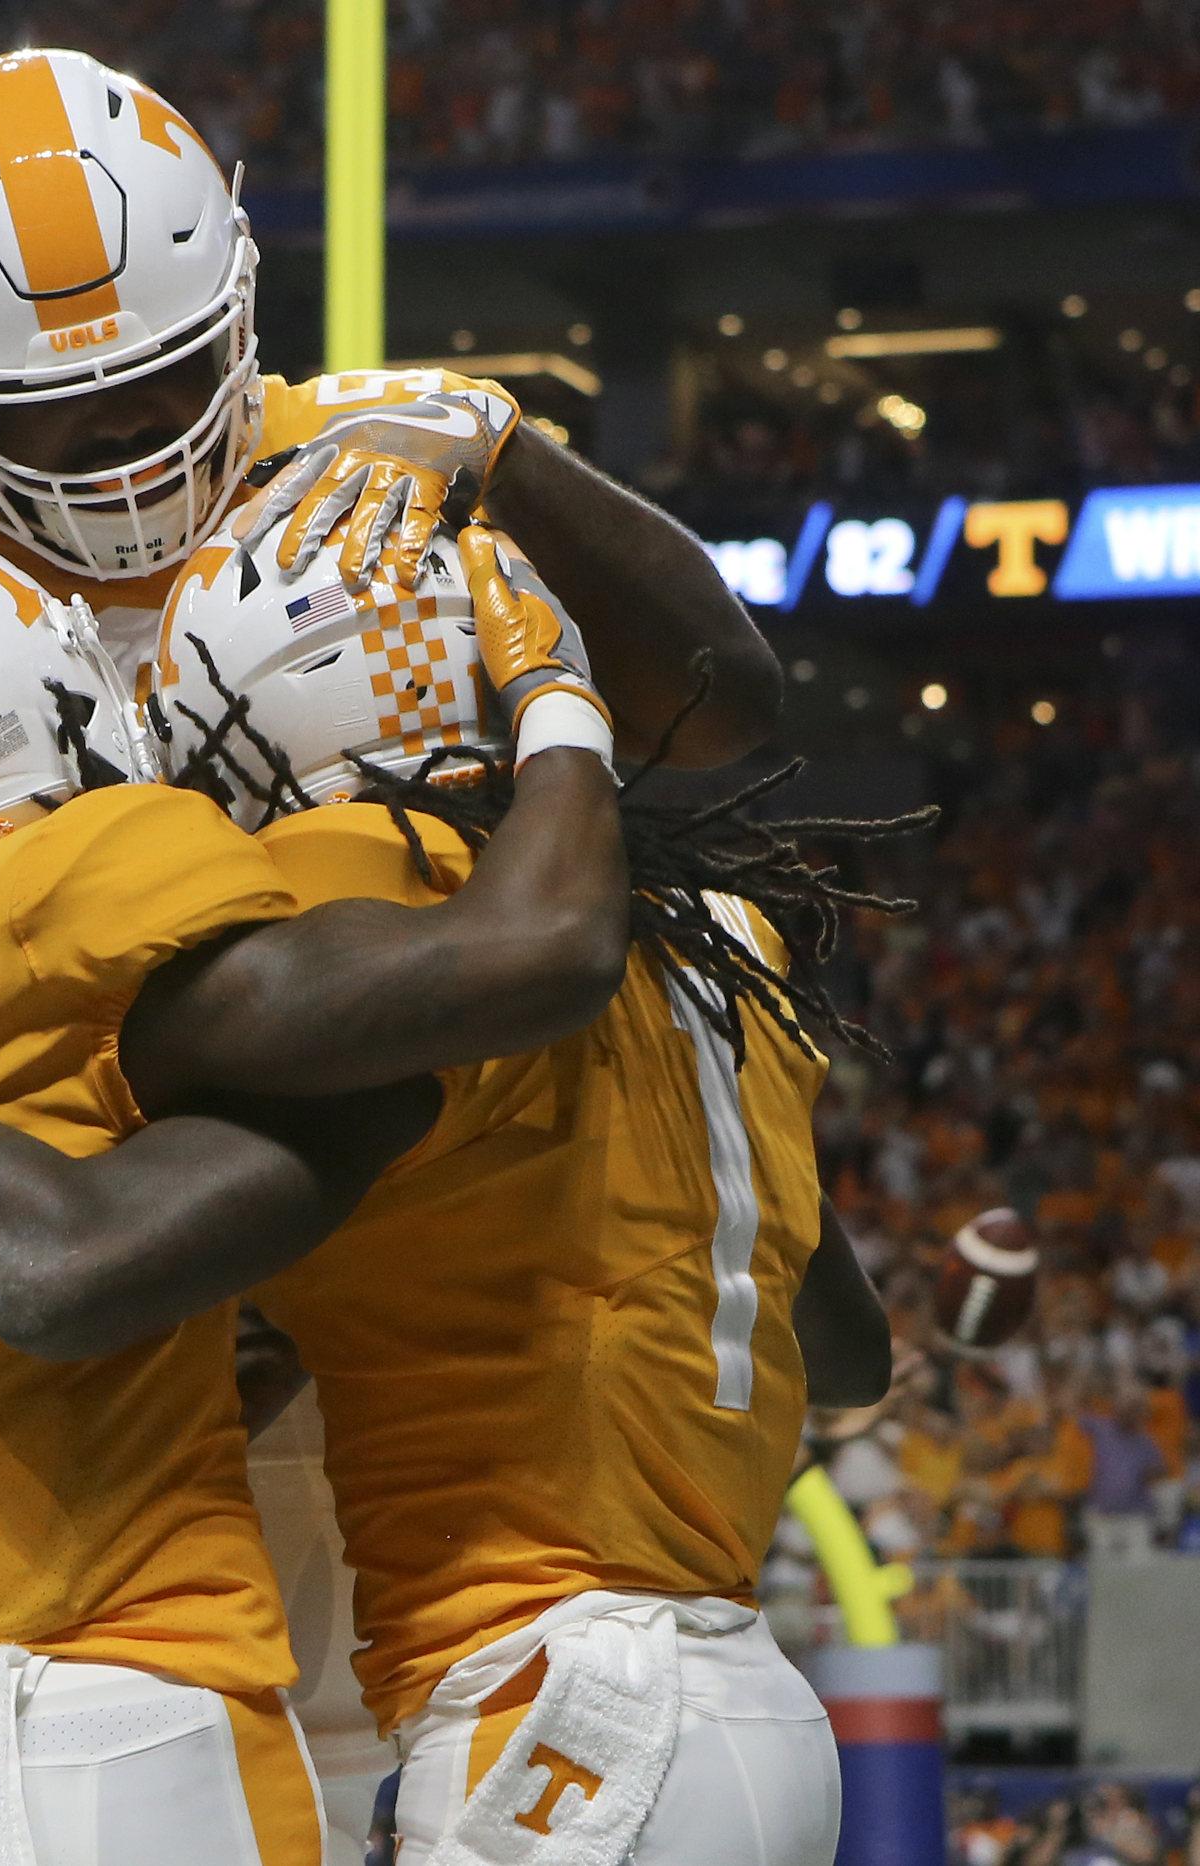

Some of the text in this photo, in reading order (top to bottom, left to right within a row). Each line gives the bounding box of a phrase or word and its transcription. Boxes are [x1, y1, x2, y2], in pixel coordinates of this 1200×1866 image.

[48, 317, 119, 354] VOLS
[115, 537, 164, 554] Ridell
[514, 1742, 604, 1835] T
